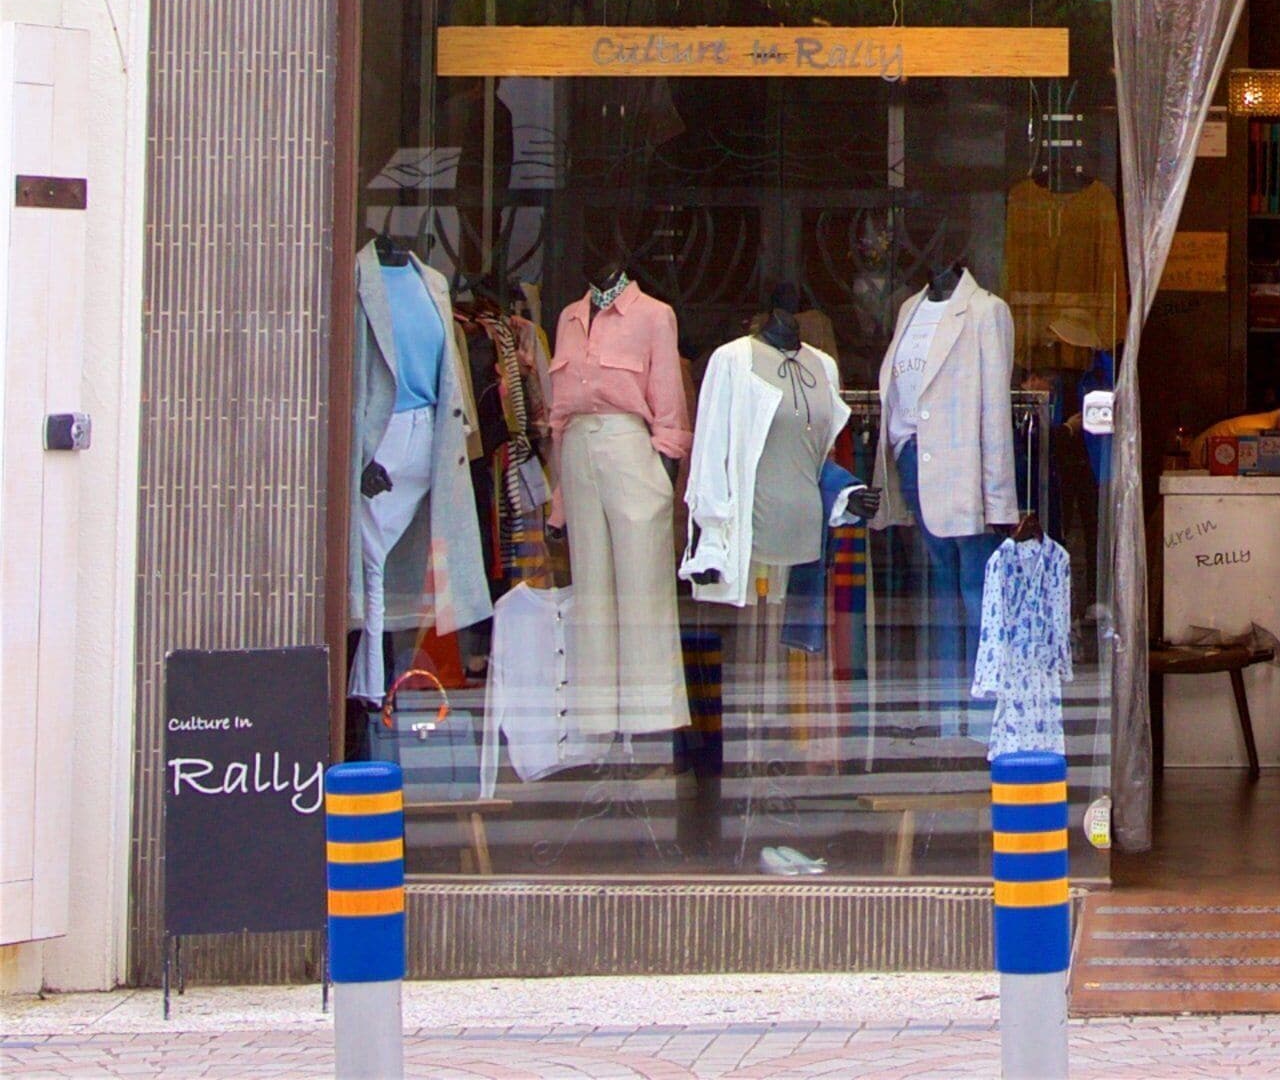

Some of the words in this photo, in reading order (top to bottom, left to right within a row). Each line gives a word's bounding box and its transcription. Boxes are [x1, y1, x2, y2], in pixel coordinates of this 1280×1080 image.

[592, 35, 728, 66] Culture
[794, 35, 905, 83] Rally
[168, 716, 230, 731] Culture
[168, 751, 324, 813] Rally
